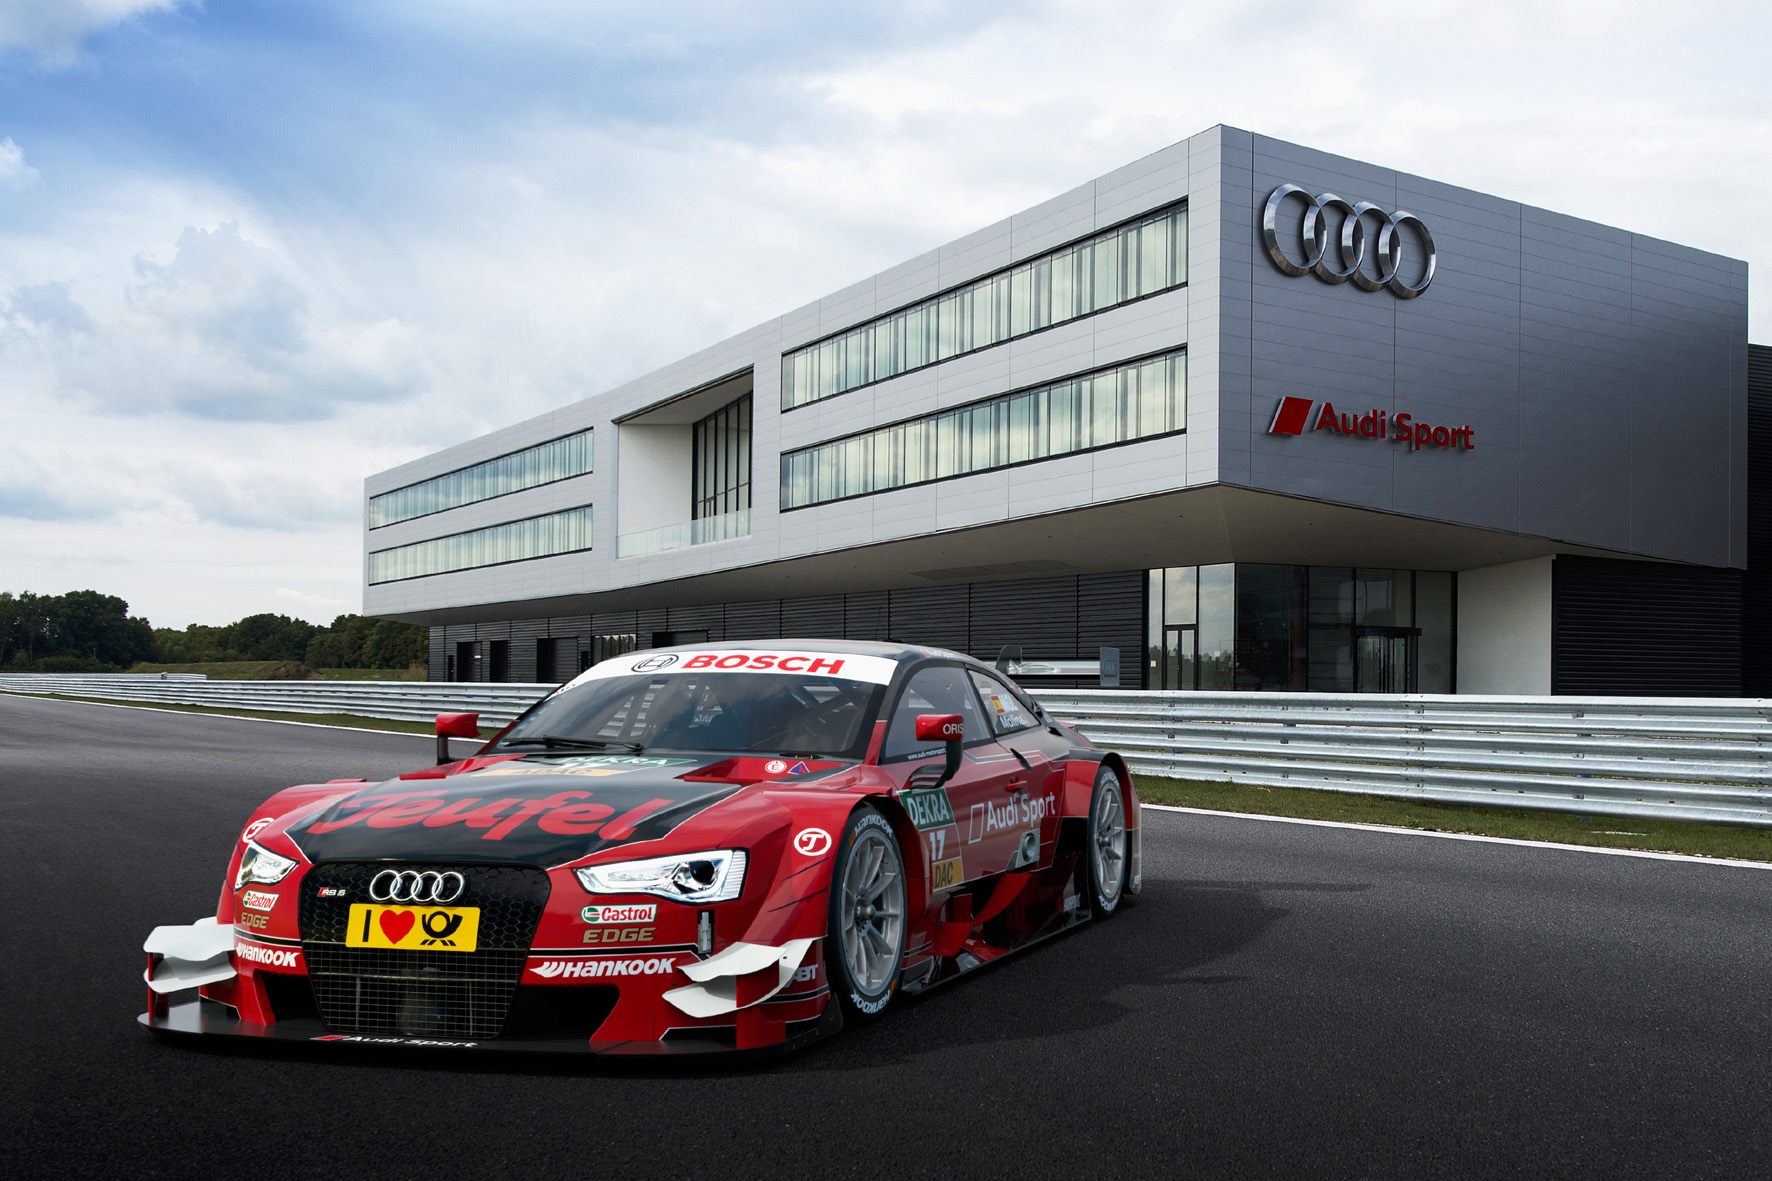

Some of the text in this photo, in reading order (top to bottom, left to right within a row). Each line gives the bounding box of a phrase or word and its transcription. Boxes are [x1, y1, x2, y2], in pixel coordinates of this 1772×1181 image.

[1314, 402, 1475, 450] Audi Sport
[681, 655, 846, 675] BOSCH
[942, 723, 964, 735] ORIS
[305, 790, 674, 841] Teufel
[906, 792, 950, 826] DEKRA
[987, 792, 1056, 832] Audi Sport
[929, 829, 946, 862] 17
[932, 861, 954, 889] DAC
[248, 893, 276, 909] Castrol
[241, 912, 270, 930] EDGE
[601, 907, 653, 922] Castrol
[582, 927, 657, 943] EDGE
[405, 1039, 478, 1048] Sport
